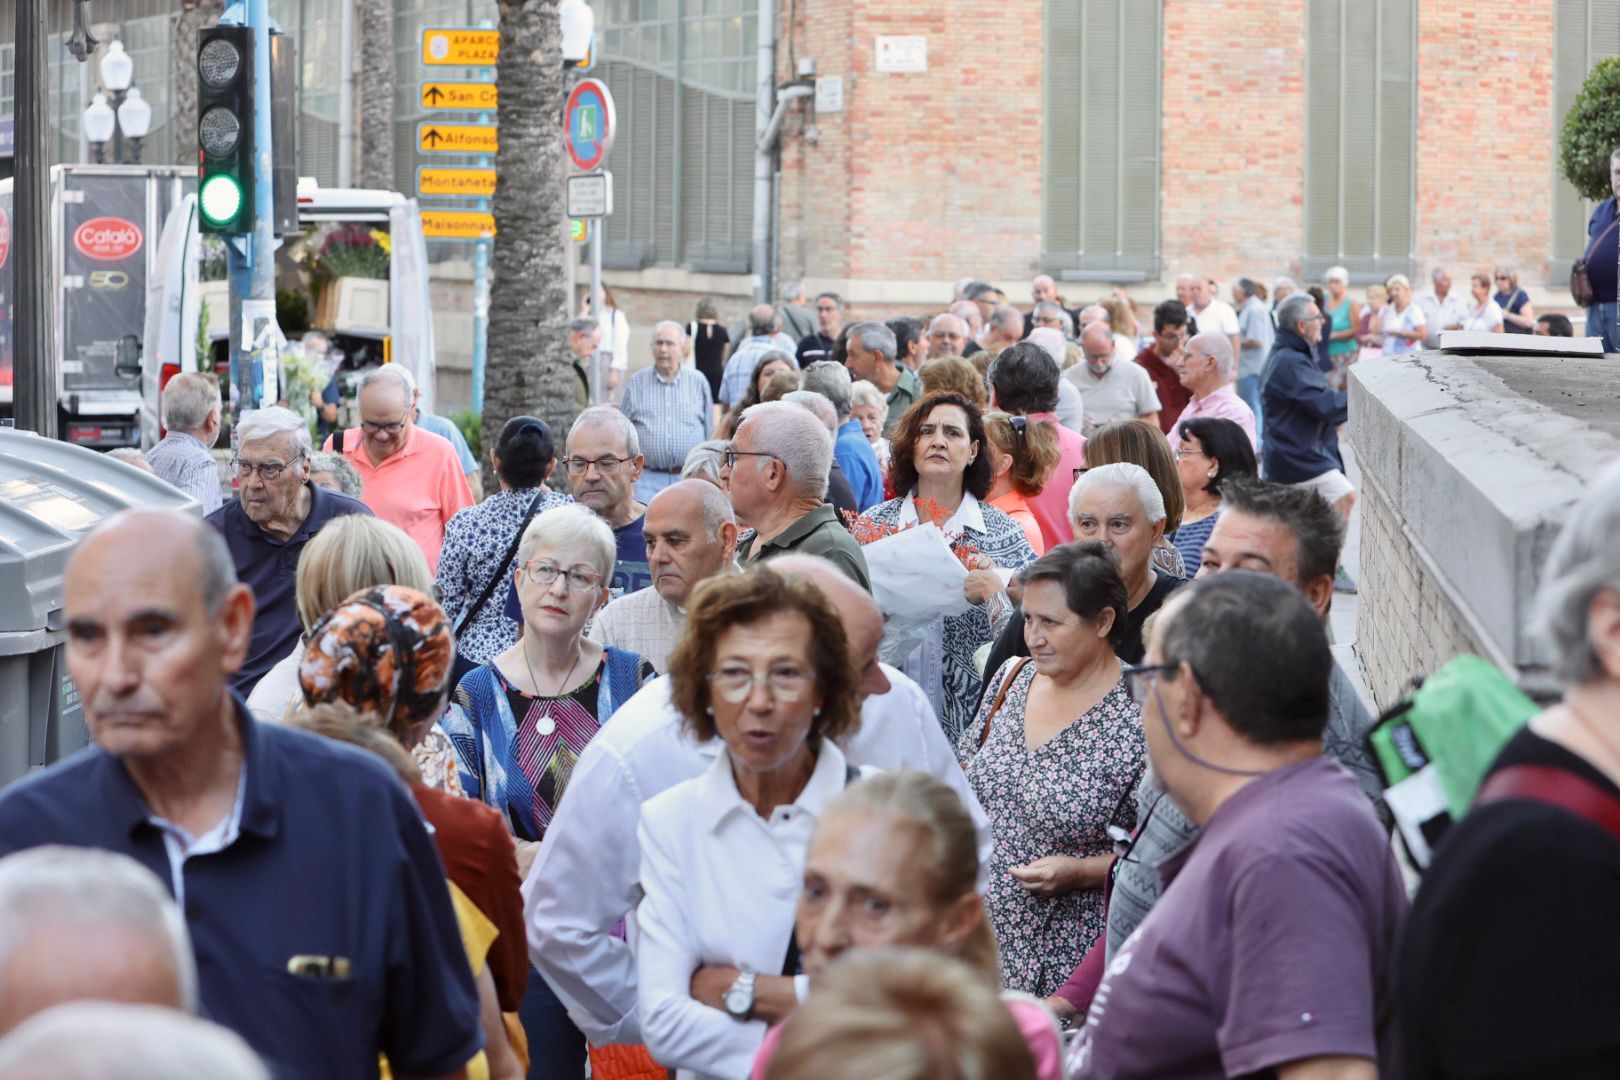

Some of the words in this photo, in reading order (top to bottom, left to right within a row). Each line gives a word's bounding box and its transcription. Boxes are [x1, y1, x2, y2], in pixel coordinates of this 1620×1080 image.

[458, 49, 494, 59] PLAZA
[448, 89, 474, 102] San
[444, 132, 496, 145] Alfonso
